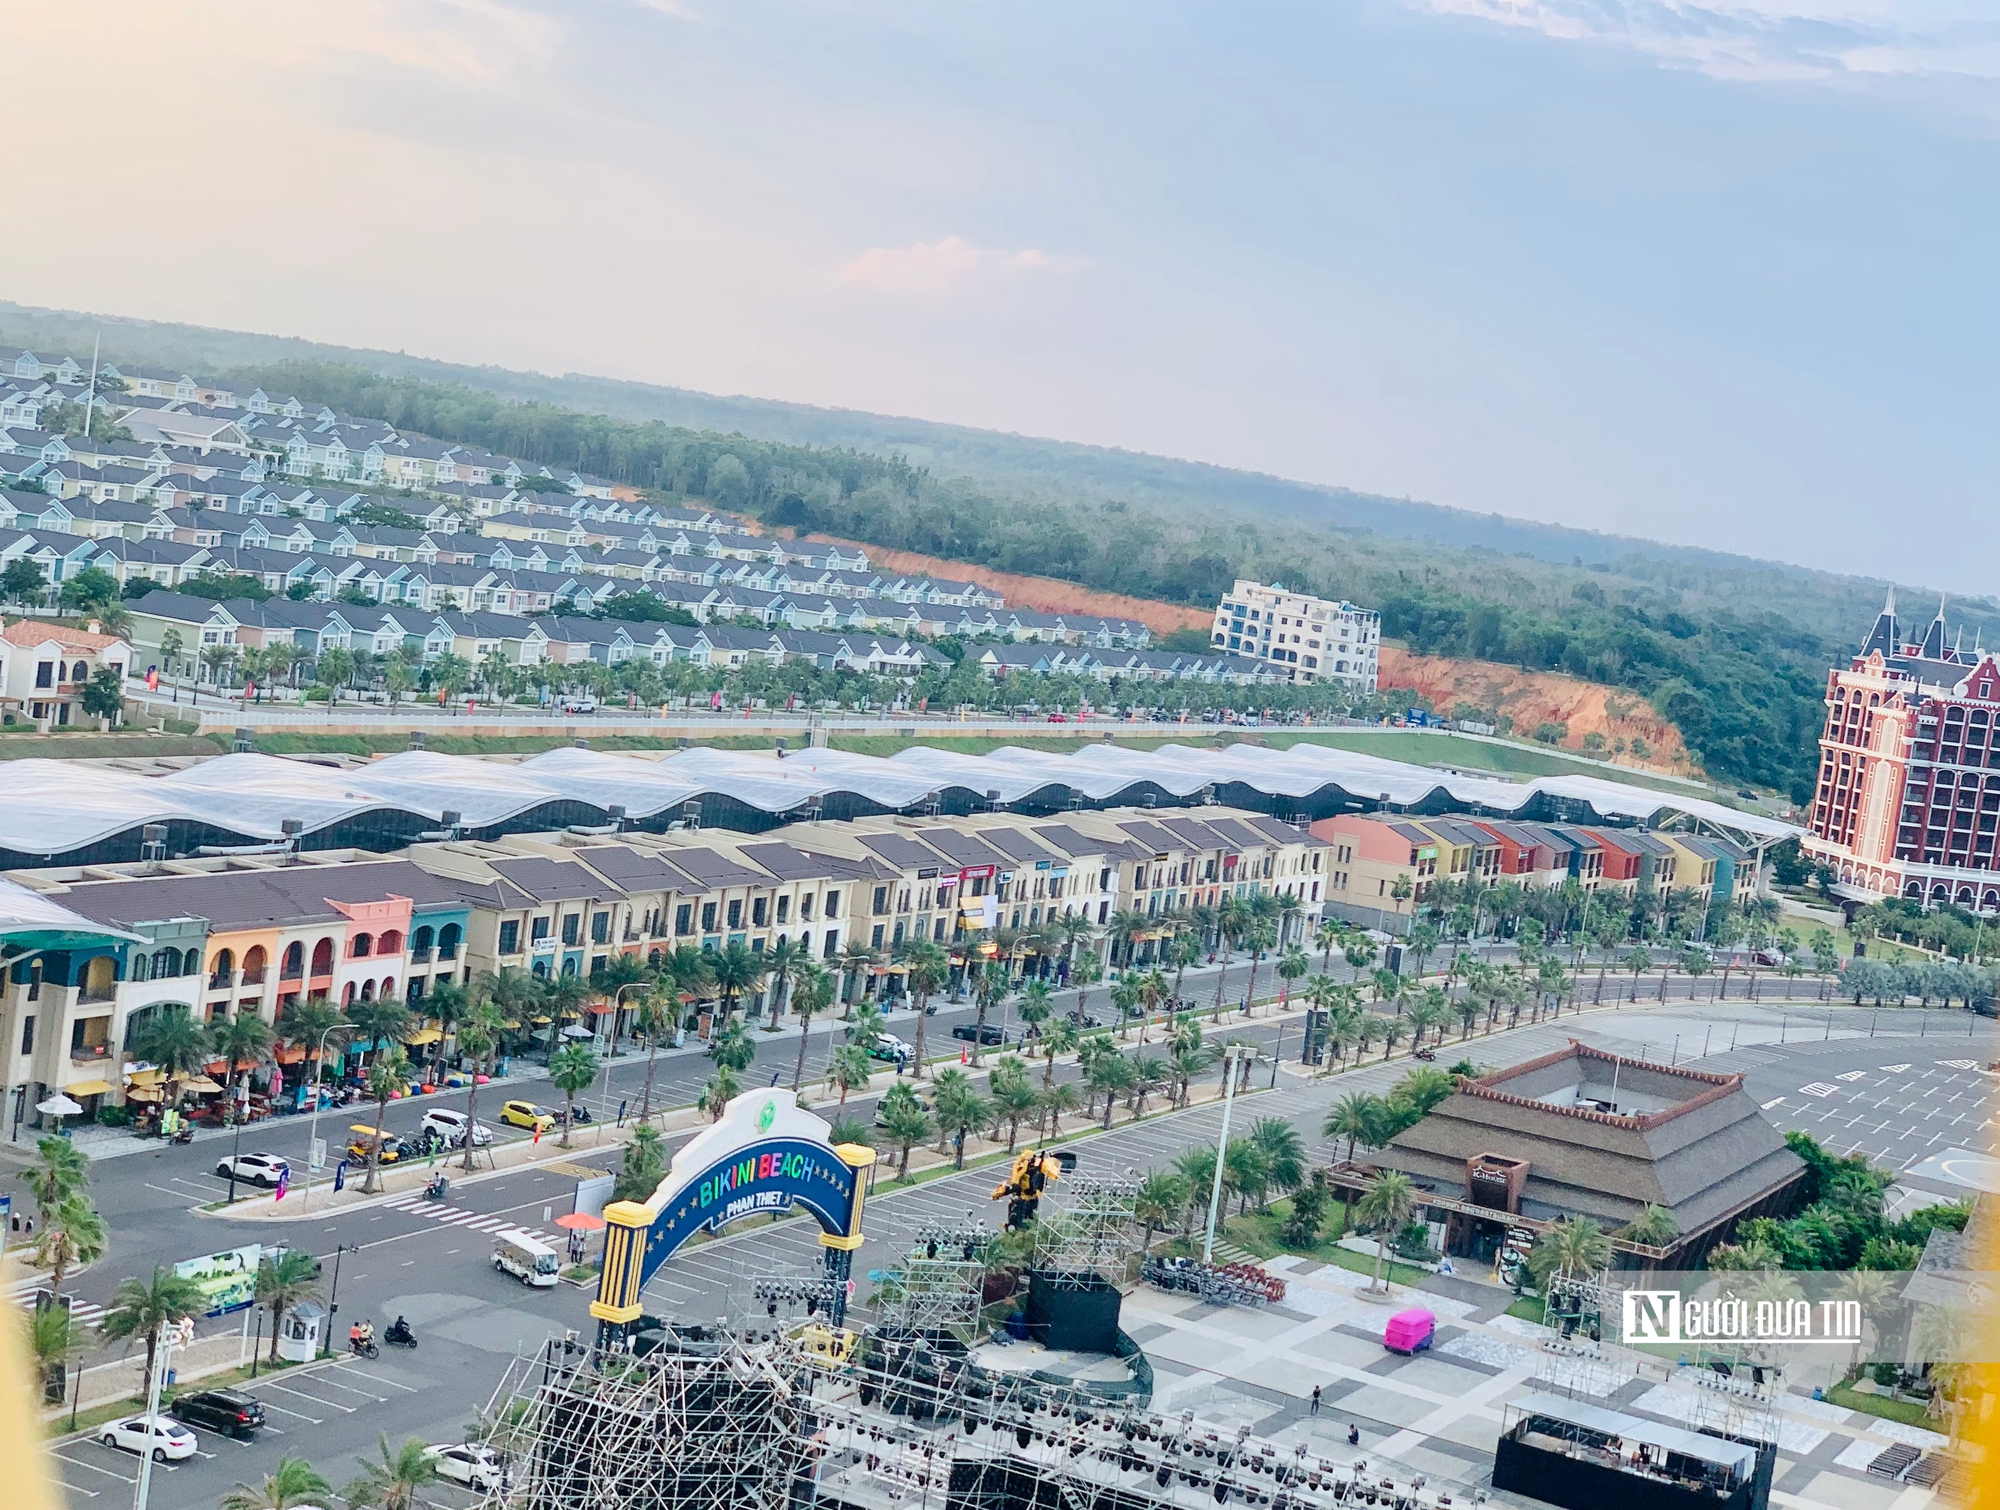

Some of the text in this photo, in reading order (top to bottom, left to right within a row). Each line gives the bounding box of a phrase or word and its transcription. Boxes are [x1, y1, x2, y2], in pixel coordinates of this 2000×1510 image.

[700, 1152, 815, 1208] BIKINI BEACH
[726, 1194, 755, 1218] PHAN
